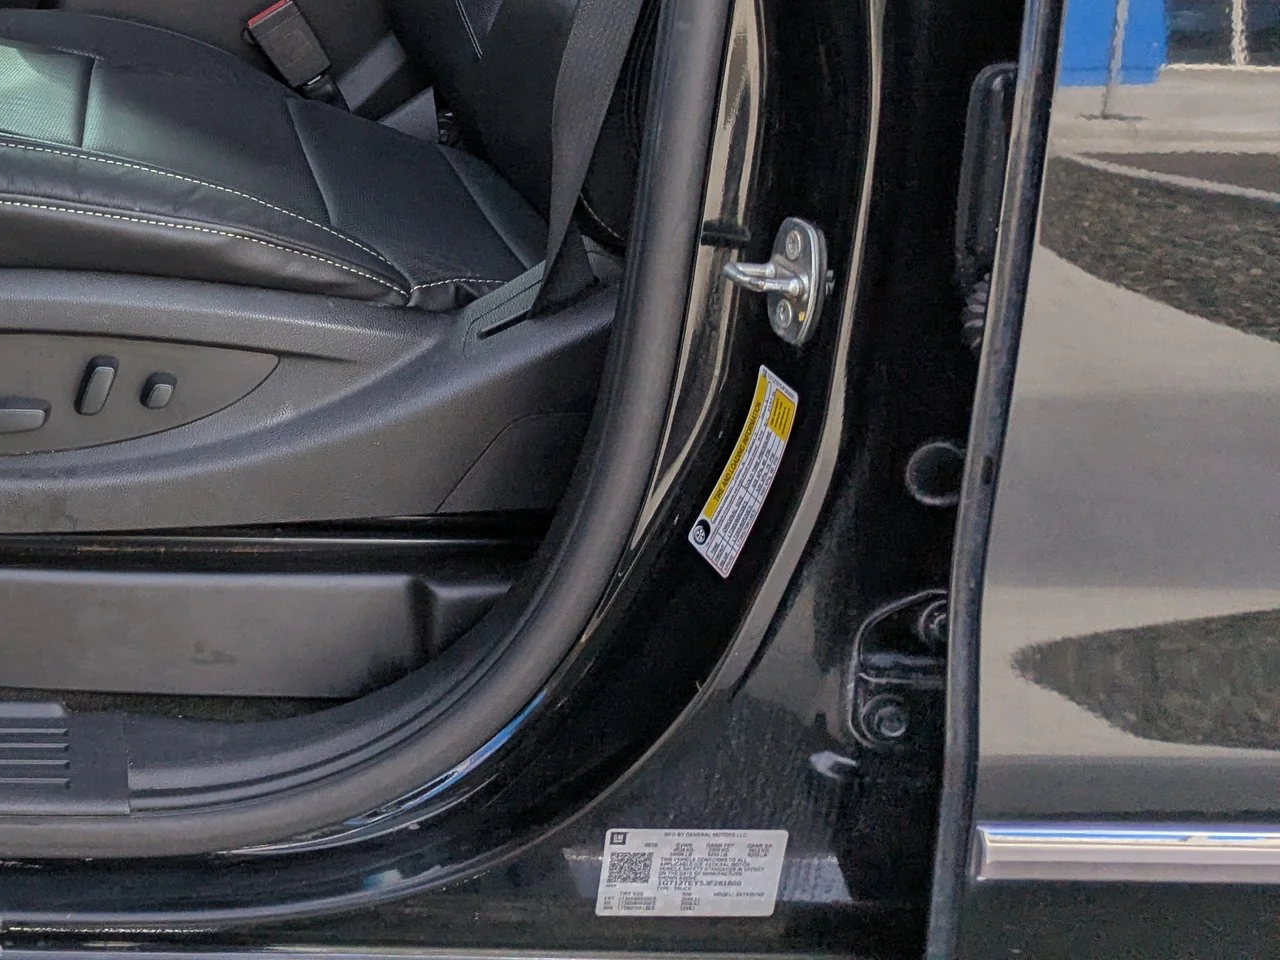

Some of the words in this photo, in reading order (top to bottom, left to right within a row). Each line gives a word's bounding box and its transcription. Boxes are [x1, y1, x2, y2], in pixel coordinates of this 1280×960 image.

[714, 486, 725, 502] TIRE
[721, 473, 732, 488] AND
[730, 444, 746, 473] LOADING
[743, 402, 761, 445] INFORMATION
